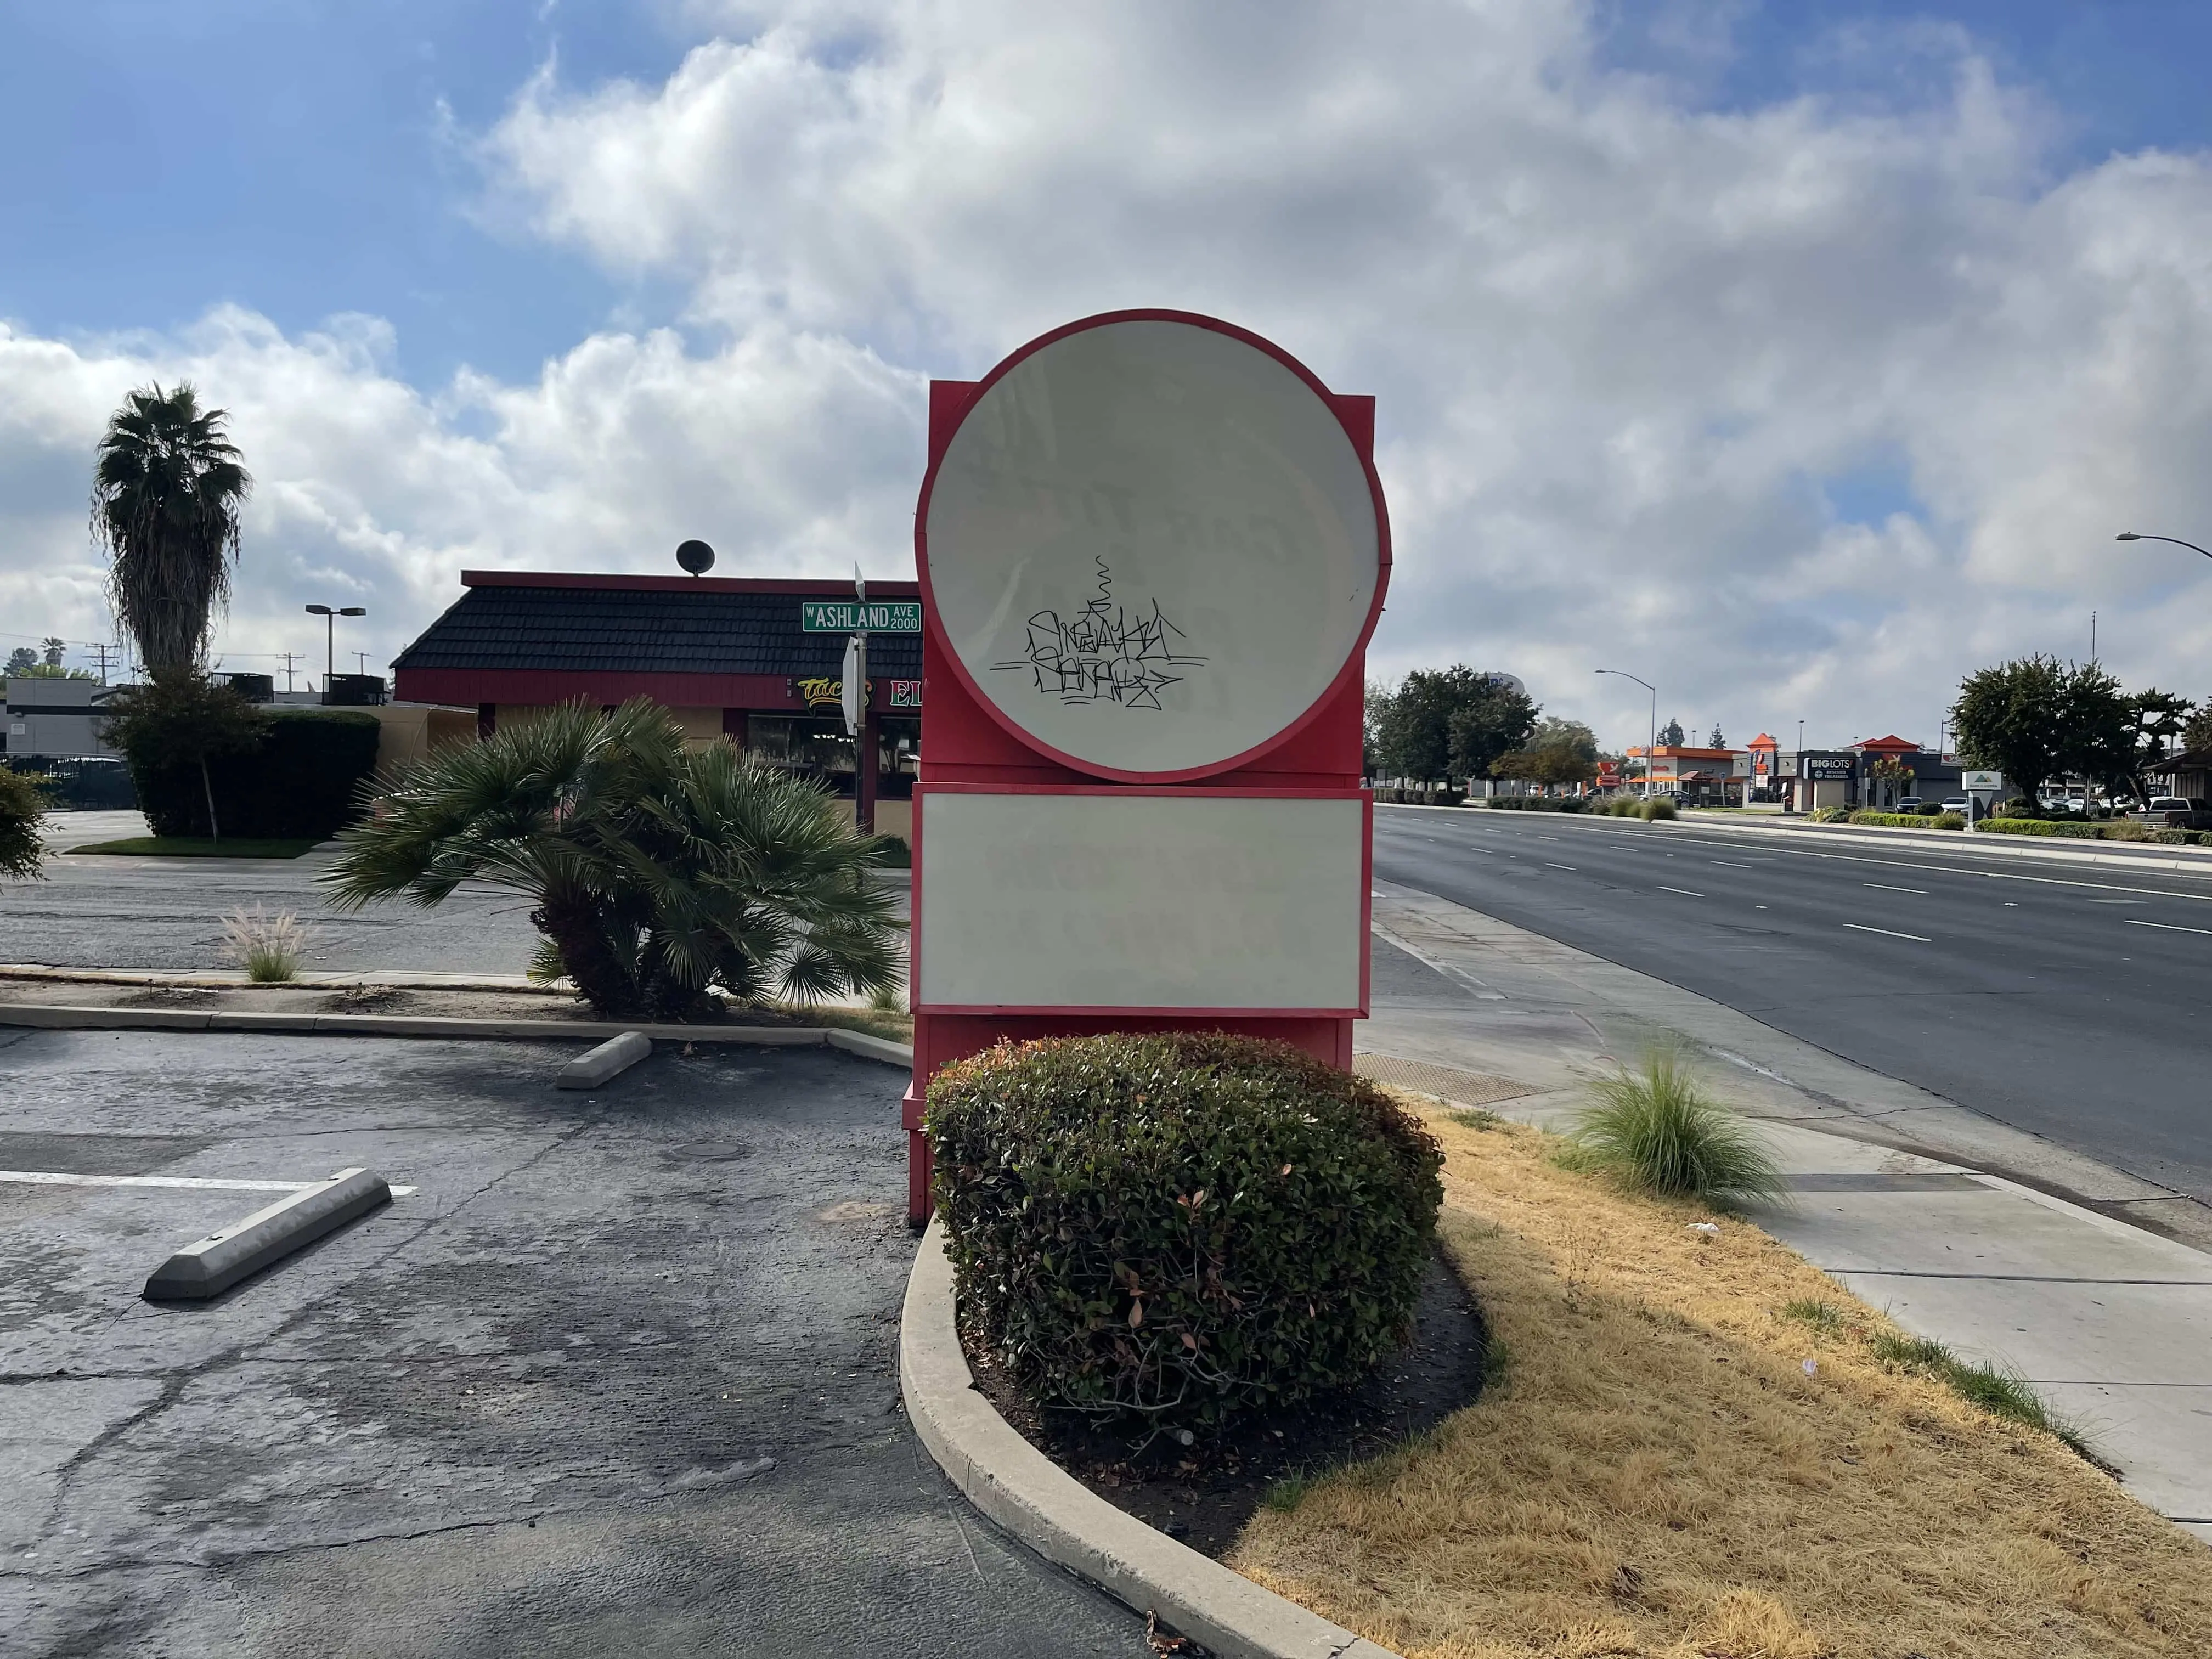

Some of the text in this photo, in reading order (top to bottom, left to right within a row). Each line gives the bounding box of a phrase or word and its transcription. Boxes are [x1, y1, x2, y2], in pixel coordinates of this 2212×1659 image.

[806, 606, 913, 628] W ASHLAND AVE
[890, 618, 917, 629] 2000
